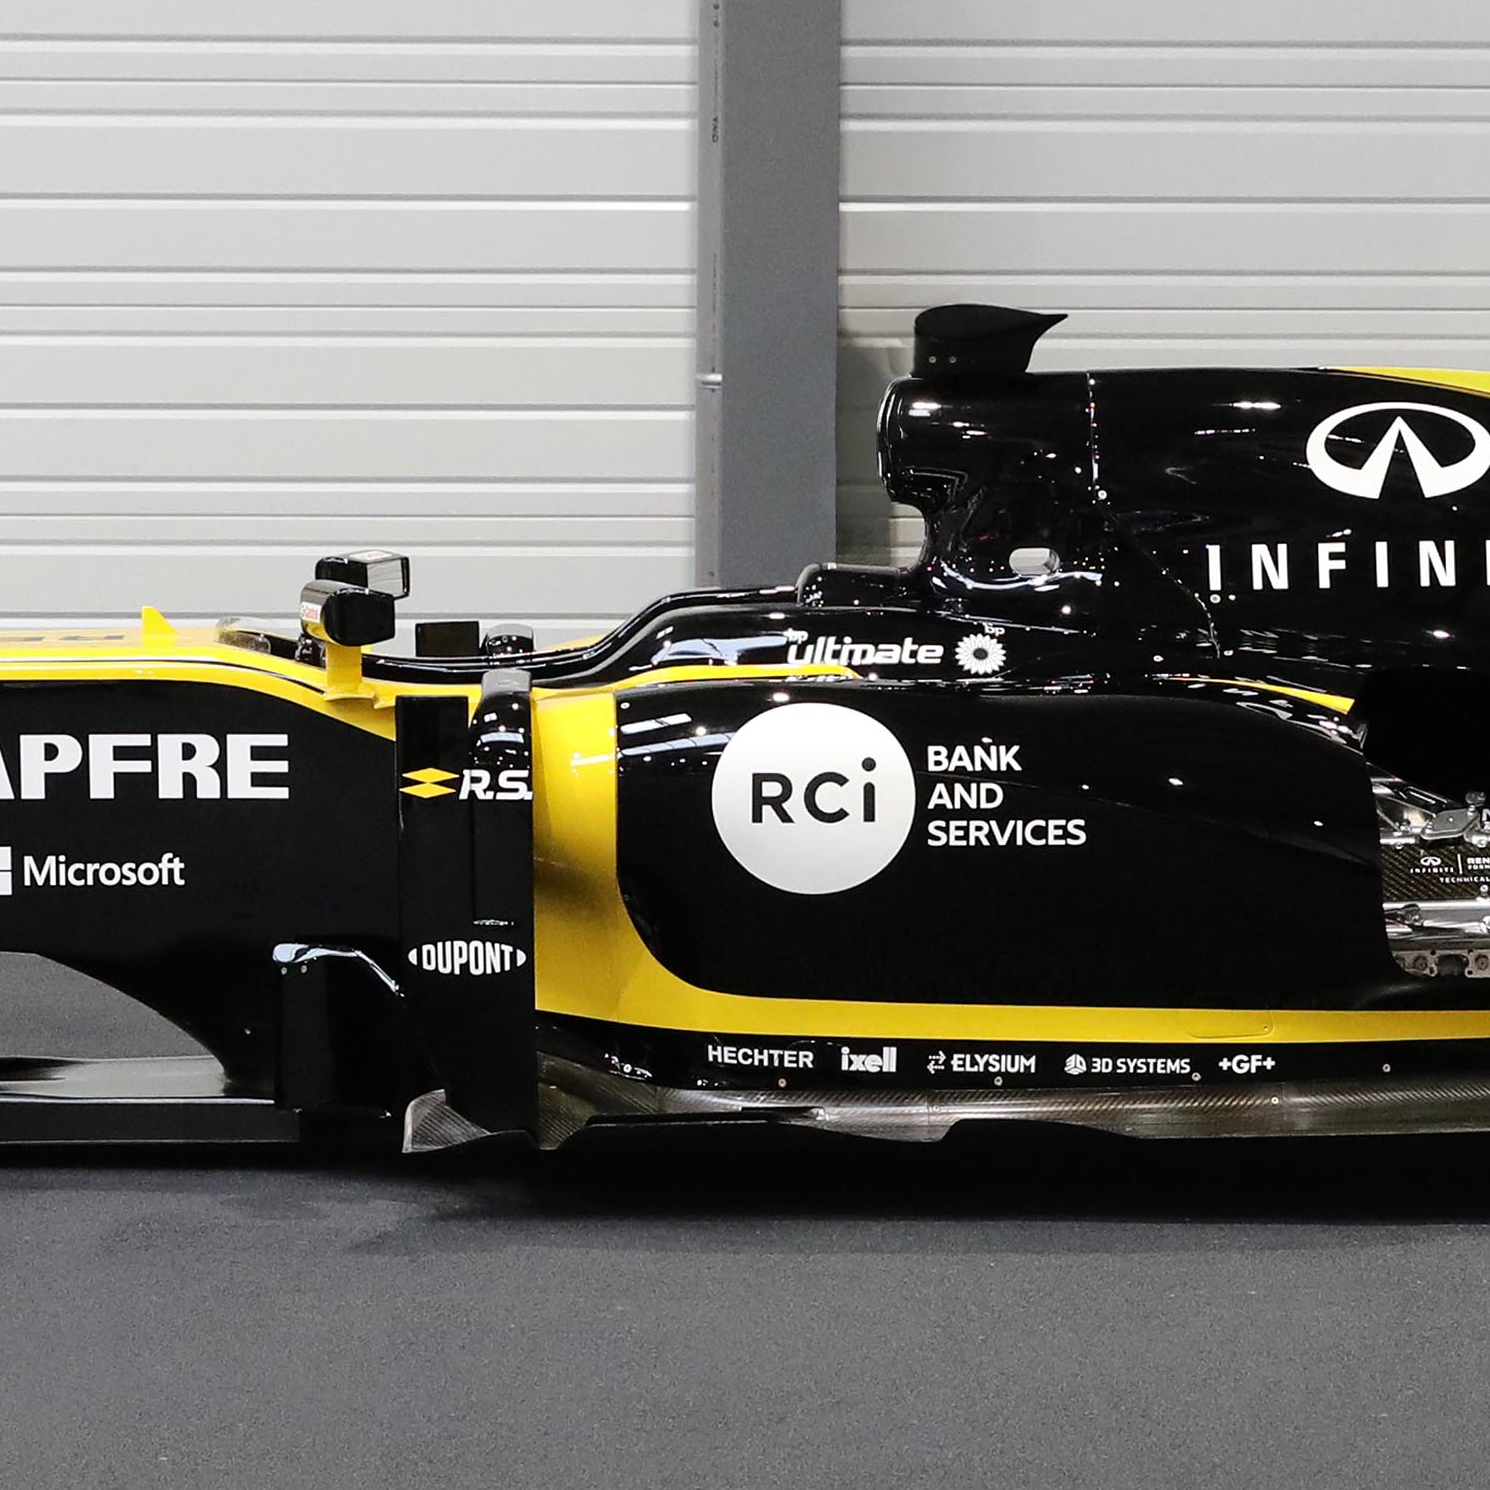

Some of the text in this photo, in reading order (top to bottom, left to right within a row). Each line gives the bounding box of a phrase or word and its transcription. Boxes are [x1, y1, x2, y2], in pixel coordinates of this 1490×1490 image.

[787, 636, 944, 665] ultimate
[927, 745, 1022, 772] BANK
[751, 757, 877, 824] RCi
[927, 783, 1004, 810] AND
[927, 819, 1087, 847] SERVICES
[23, 852, 185, 886] Microsoft
[1409, 866, 1455, 874] INFINITI
[1439, 875, 1490, 884] TECHNICAL
[421, 940, 514, 976] DUPONT
[707, 1044, 814, 1068] HECHTER
[840, 1046, 897, 1073] ixell
[950, 1053, 1036, 1073] ELYSIUM
[1091, 1057, 1191, 1074] 3D SYSTEMS
